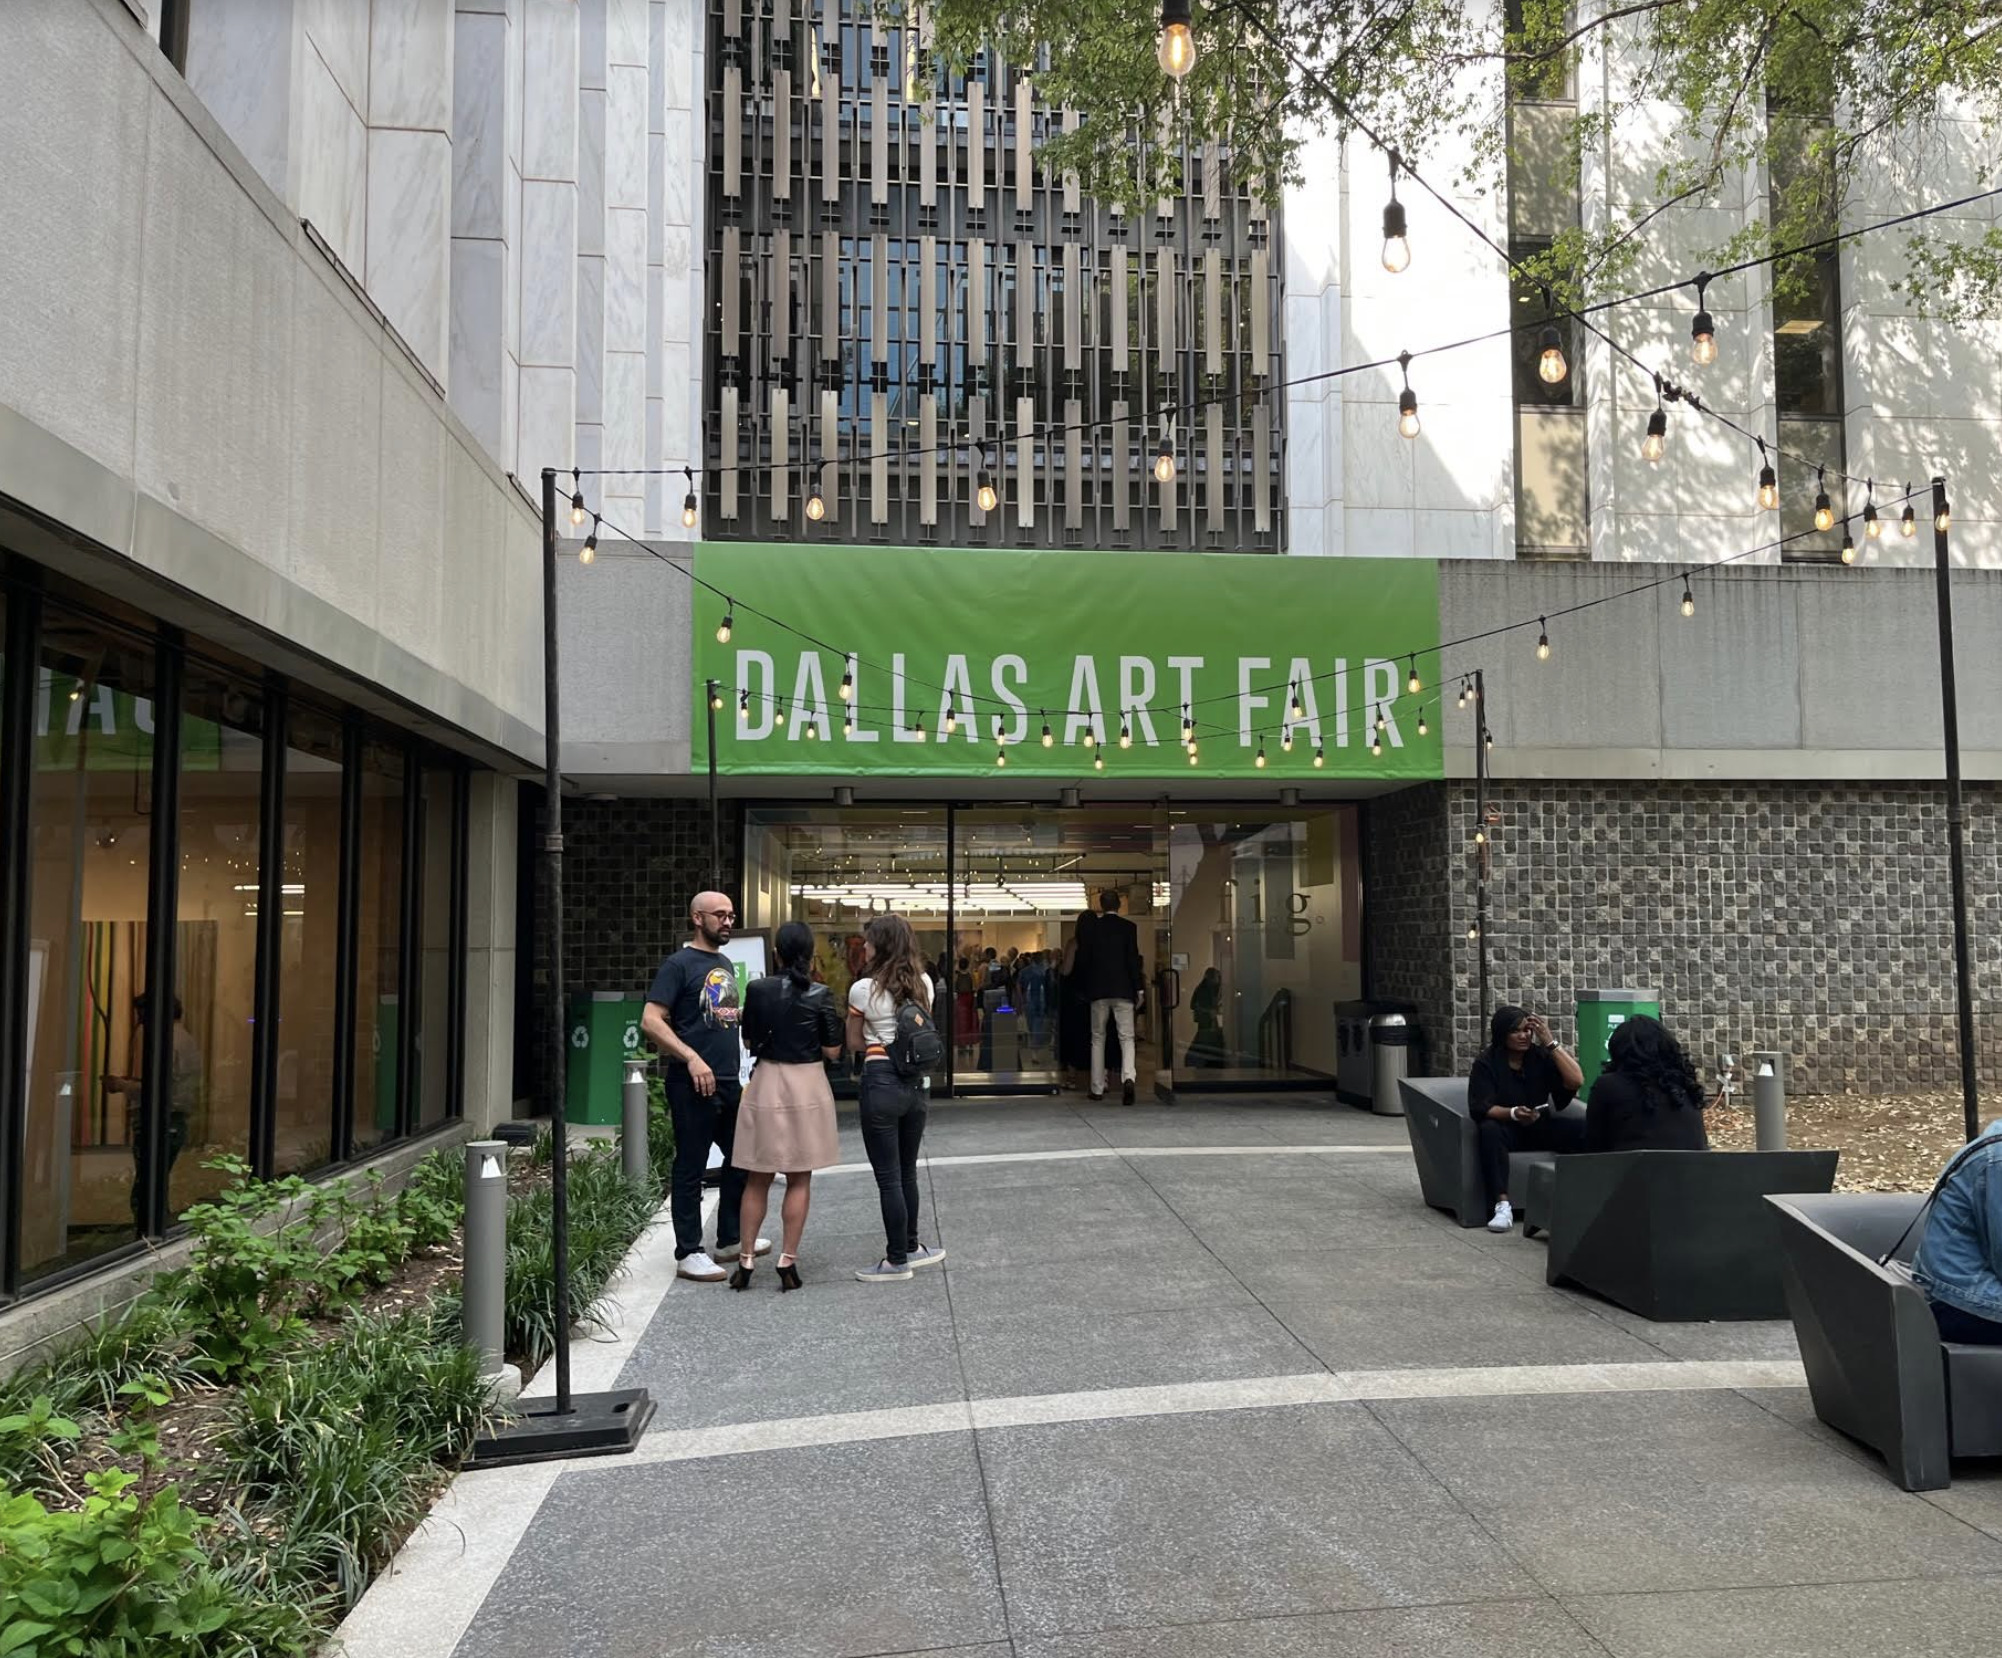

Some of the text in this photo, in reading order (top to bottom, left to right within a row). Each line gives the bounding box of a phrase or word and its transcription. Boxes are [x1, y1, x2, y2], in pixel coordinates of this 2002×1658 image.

[736, 649, 1404, 748] DALLAS ART FAIR
